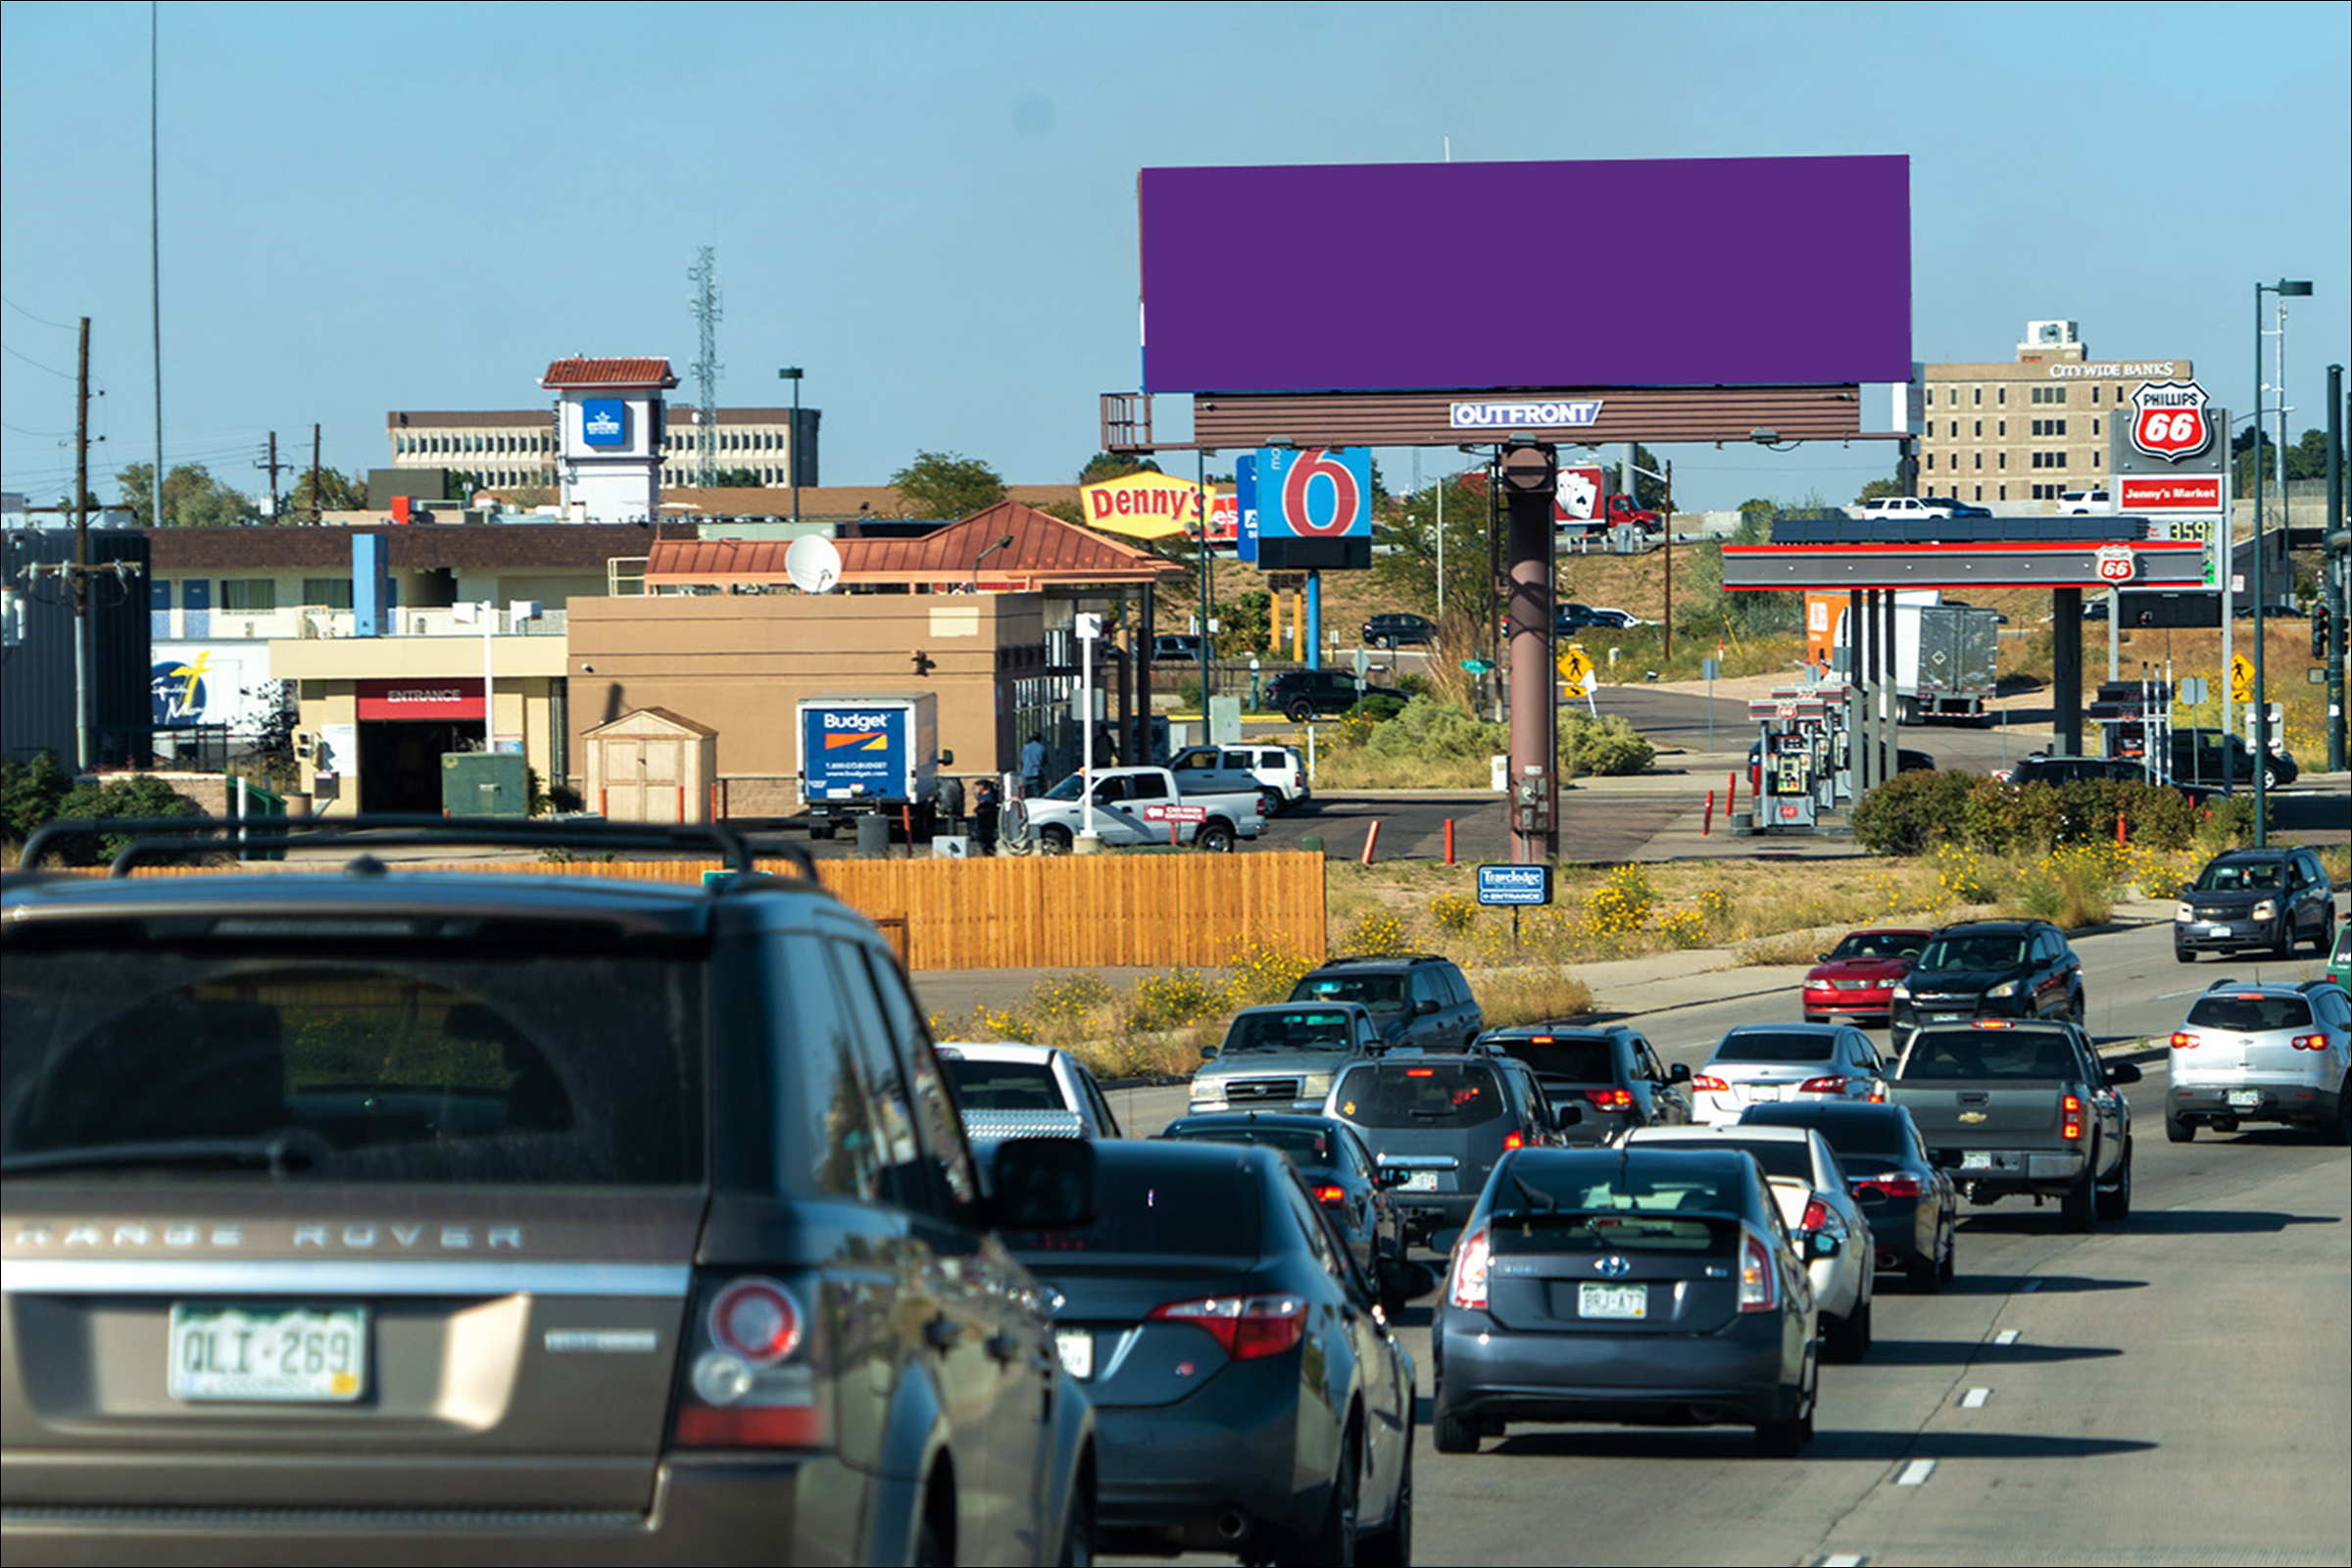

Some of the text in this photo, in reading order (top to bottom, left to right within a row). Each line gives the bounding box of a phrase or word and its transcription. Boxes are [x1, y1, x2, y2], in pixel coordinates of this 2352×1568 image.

[2050, 362, 2174, 378] CITYWIDE BANKS
[2143, 393, 2198, 407] PHILLIPS
[1456, 404, 1594, 423] OUTFRONT
[2144, 413, 2195, 442] 66
[2125, 487, 2216, 500] Jenny's Market
[1091, 486, 1207, 520] Denny's
[2104, 562, 2129, 576] 66
[387, 689, 462, 703] ENTRANCE
[824, 712, 888, 732] Budget
[15, 1223, 524, 1248] RANGE ROVER
